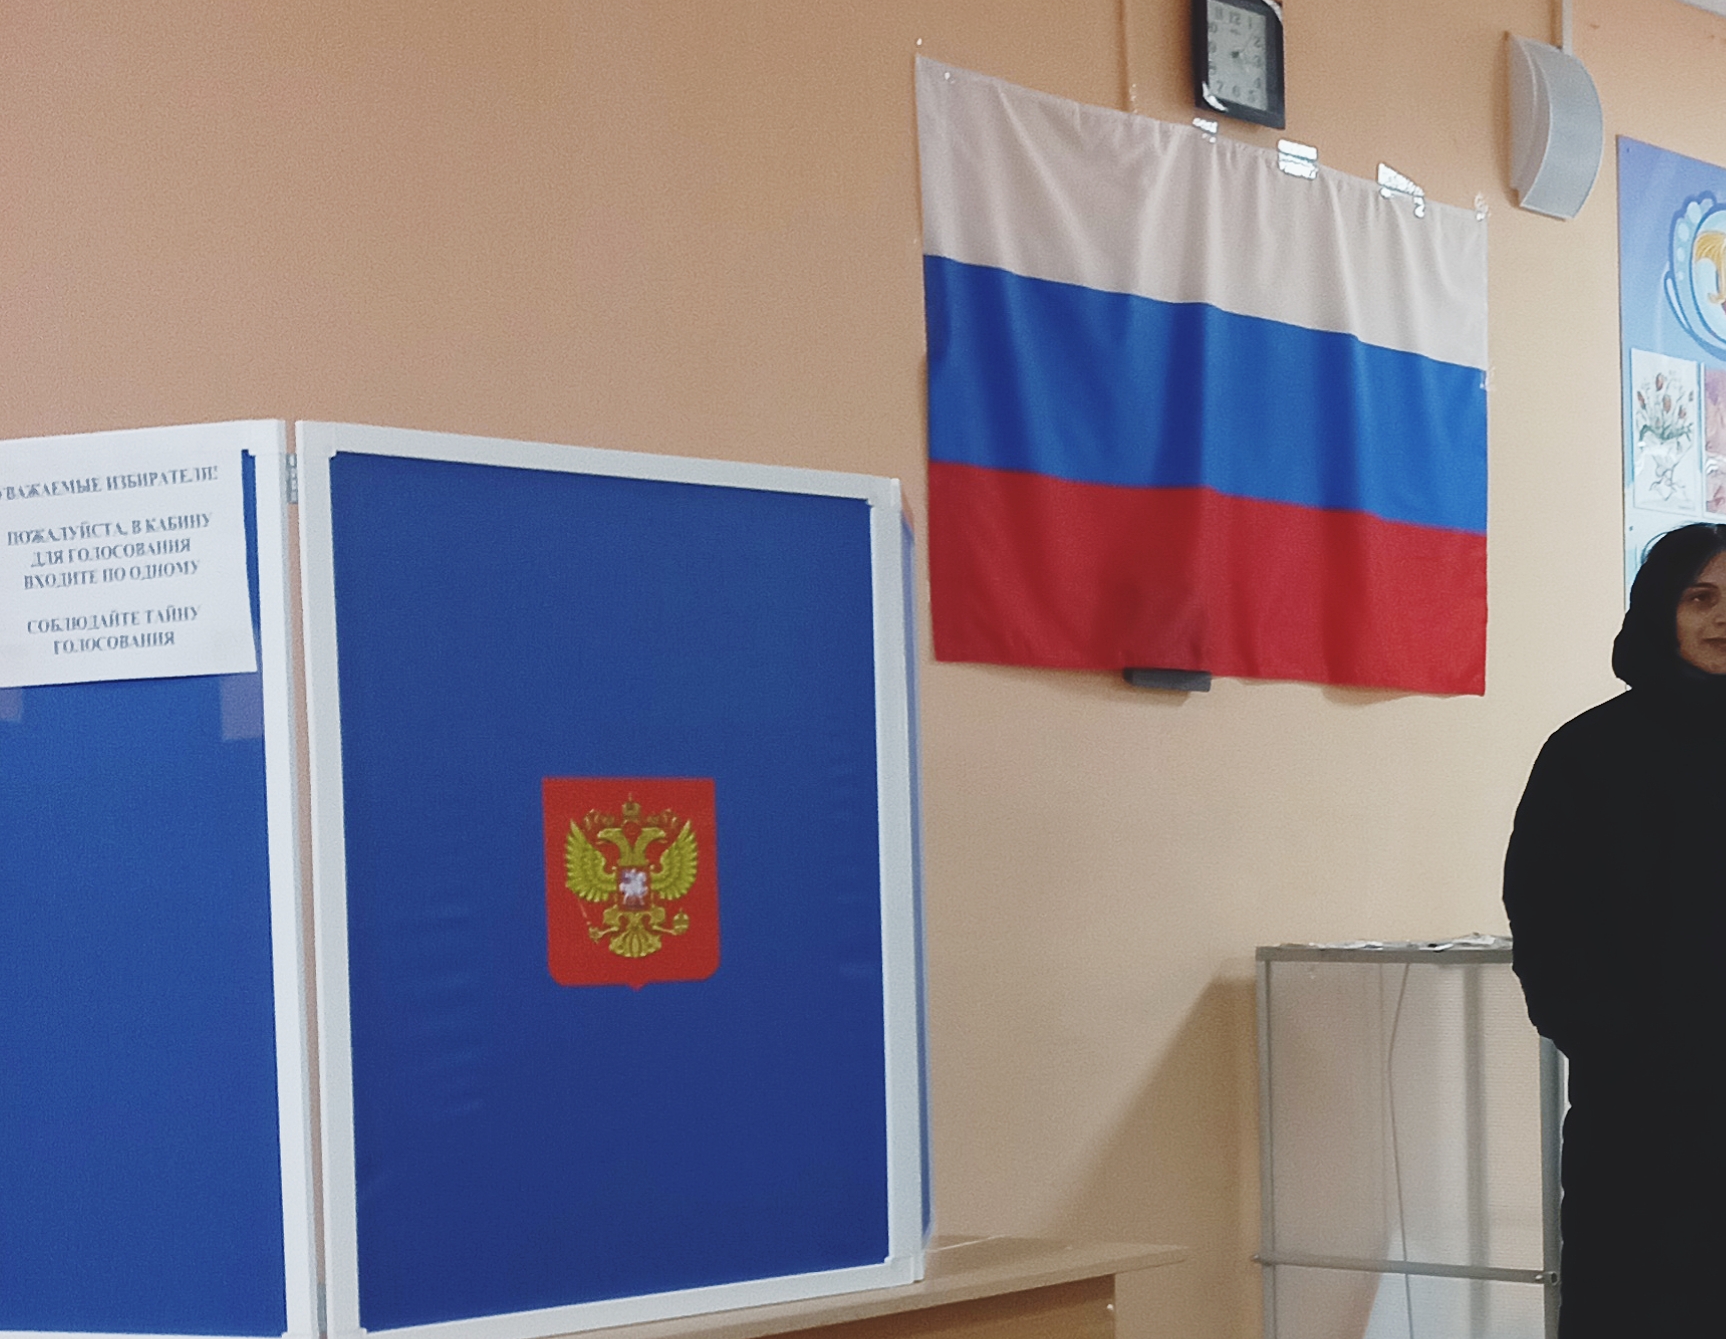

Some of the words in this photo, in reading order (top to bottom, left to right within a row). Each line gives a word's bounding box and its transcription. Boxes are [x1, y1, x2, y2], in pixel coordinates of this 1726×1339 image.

[0, 477, 102, 501] ВАЖАЕМЫЕ
[106, 465, 218, 492] ИЗБИРАТЕЛИ!
[131, 519, 142, 535] В
[145, 512, 212, 534] КАБИНУ
[31, 549, 64, 568] ДЛЯ
[67, 537, 192, 564] ГОЛОСОВАНИЯ
[24, 569, 98, 590] ВХОДИТЕ
[102, 567, 127, 583] ПО
[129, 559, 200, 581] ОДНОМУ
[27, 610, 140, 635] СОБЛЮДАЙТЕ
[144, 604, 201, 625] ТАЙНУ
[53, 631, 175, 656] ГОЛОСОВАНИЯ
